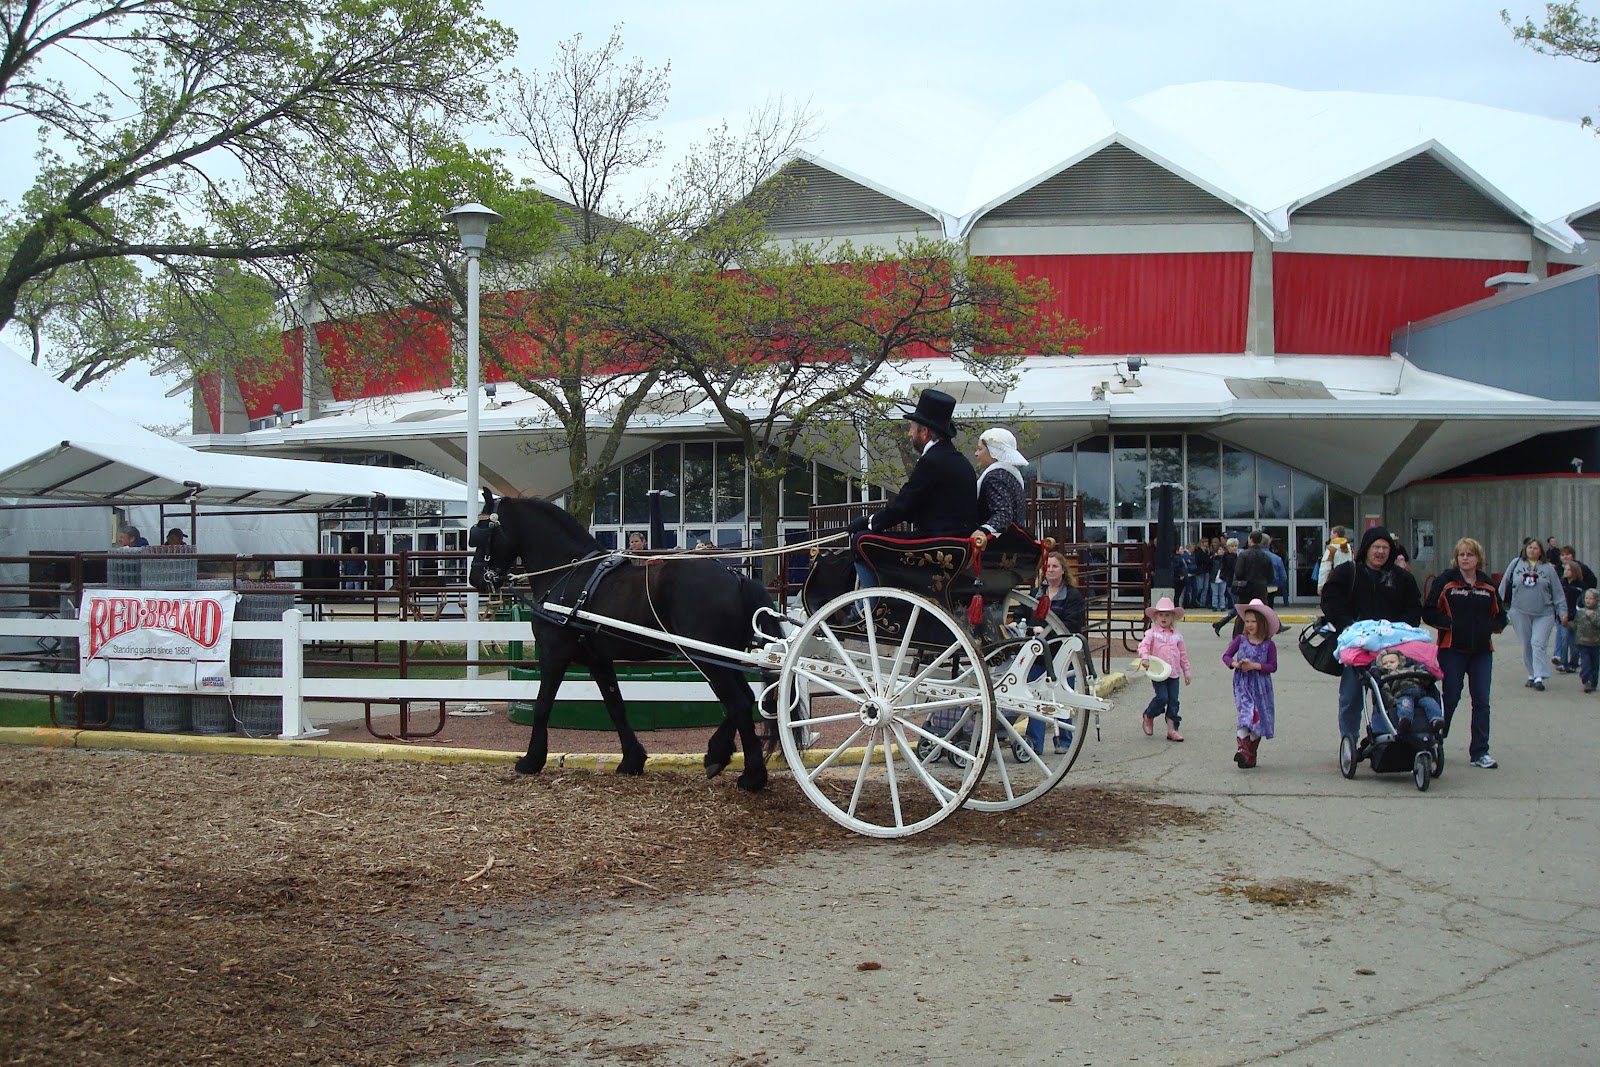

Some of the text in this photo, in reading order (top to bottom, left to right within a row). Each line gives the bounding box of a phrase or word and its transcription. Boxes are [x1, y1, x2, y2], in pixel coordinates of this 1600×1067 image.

[113, 645, 138, 656] Standing
[139, 646, 157, 656] guard
[157, 647, 173, 655] since
